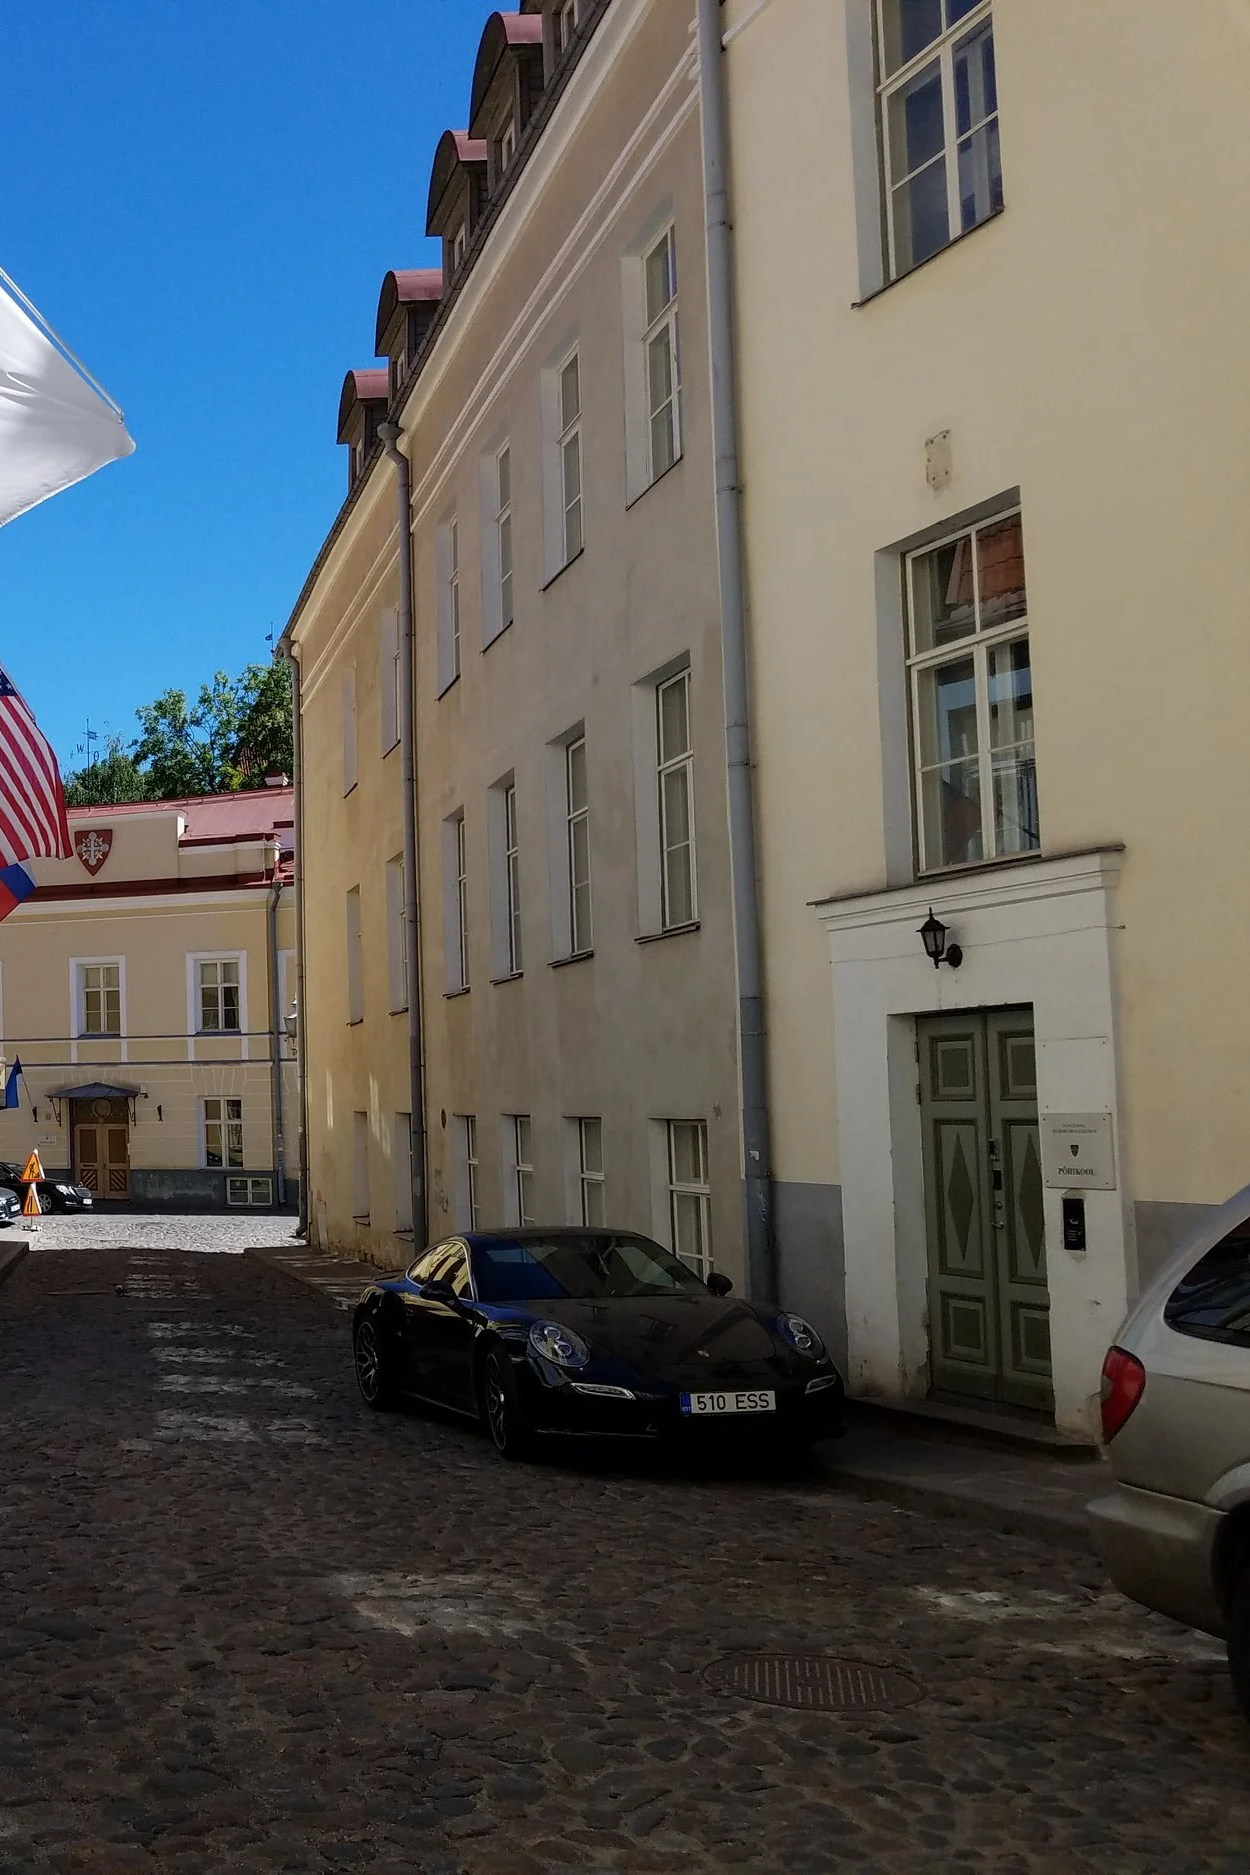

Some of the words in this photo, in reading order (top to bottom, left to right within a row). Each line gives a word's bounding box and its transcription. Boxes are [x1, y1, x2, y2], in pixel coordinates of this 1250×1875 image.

[1058, 1165, 1096, 1176] PÕHIKOOL
[696, 1394, 726, 1411] 510
[735, 1393, 770, 1410] ESS
